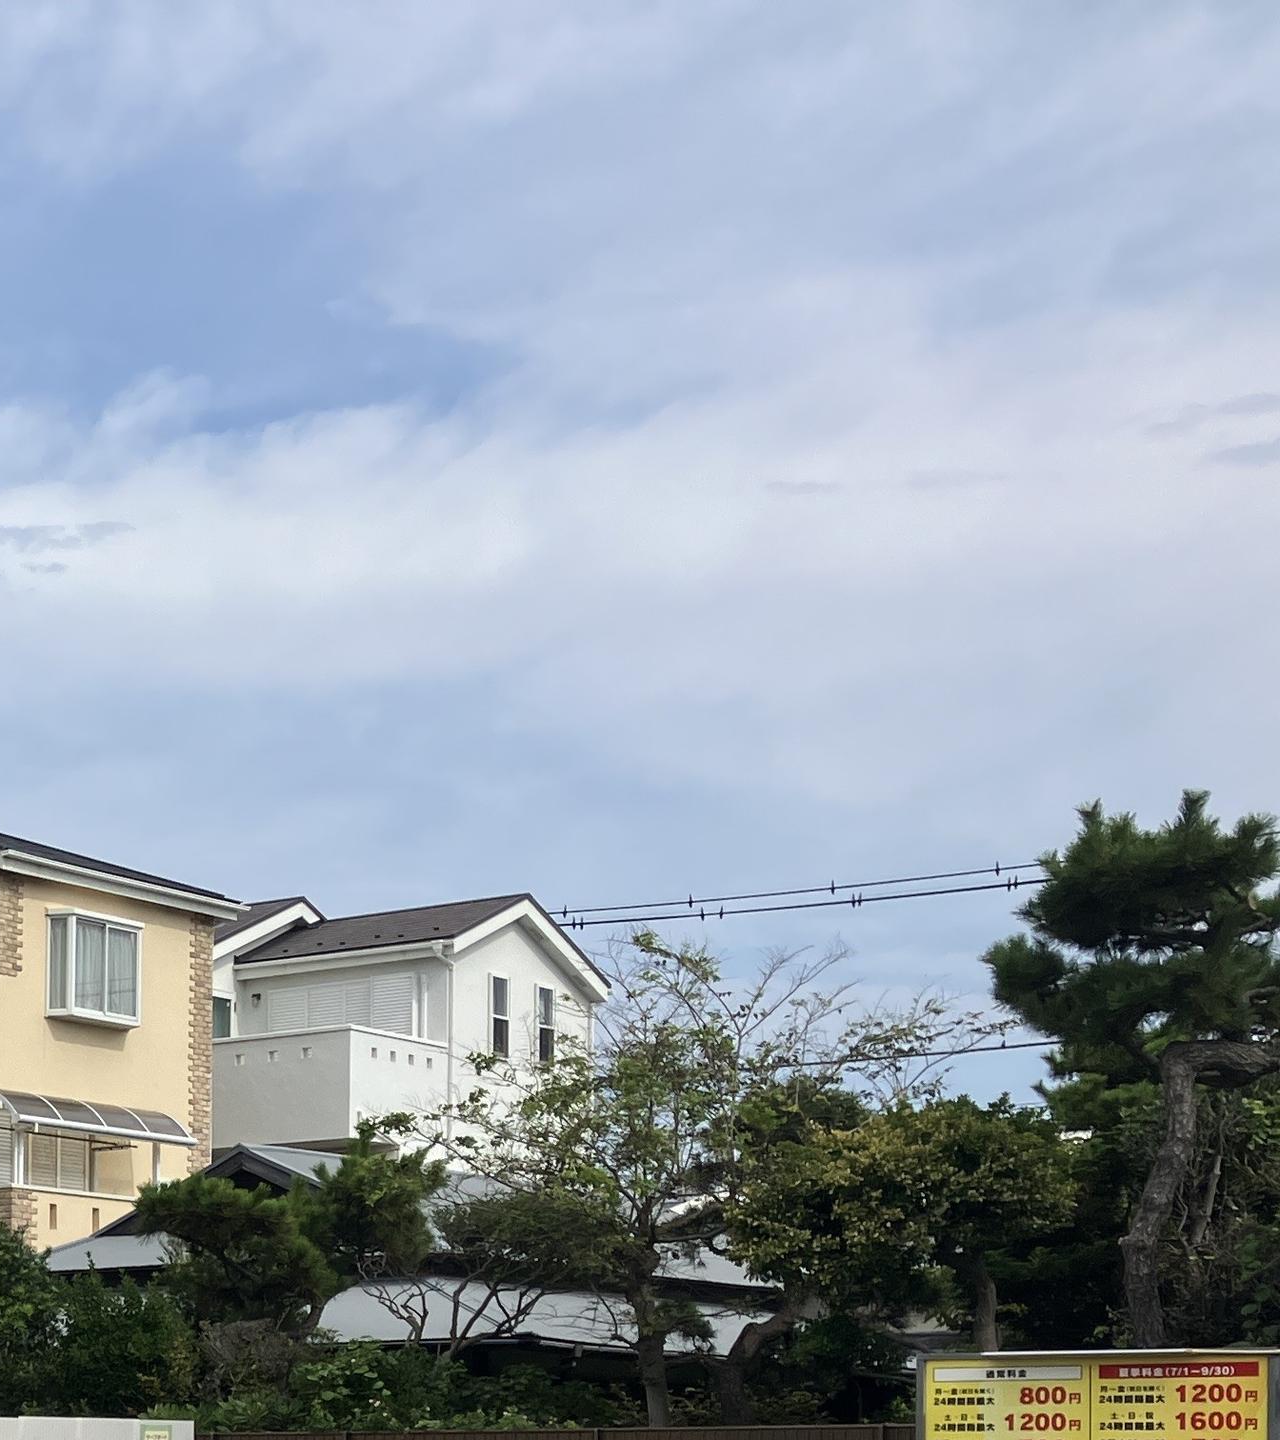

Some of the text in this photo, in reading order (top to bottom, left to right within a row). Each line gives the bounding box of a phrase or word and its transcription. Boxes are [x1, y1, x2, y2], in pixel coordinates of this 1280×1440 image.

[1019, 1386, 1081, 1405] 800円
[1175, 1383, 1258, 1403] 1200円
[1004, 1412, 1081, 1432] 1200円
[1175, 1411, 1258, 1431] 1600円
